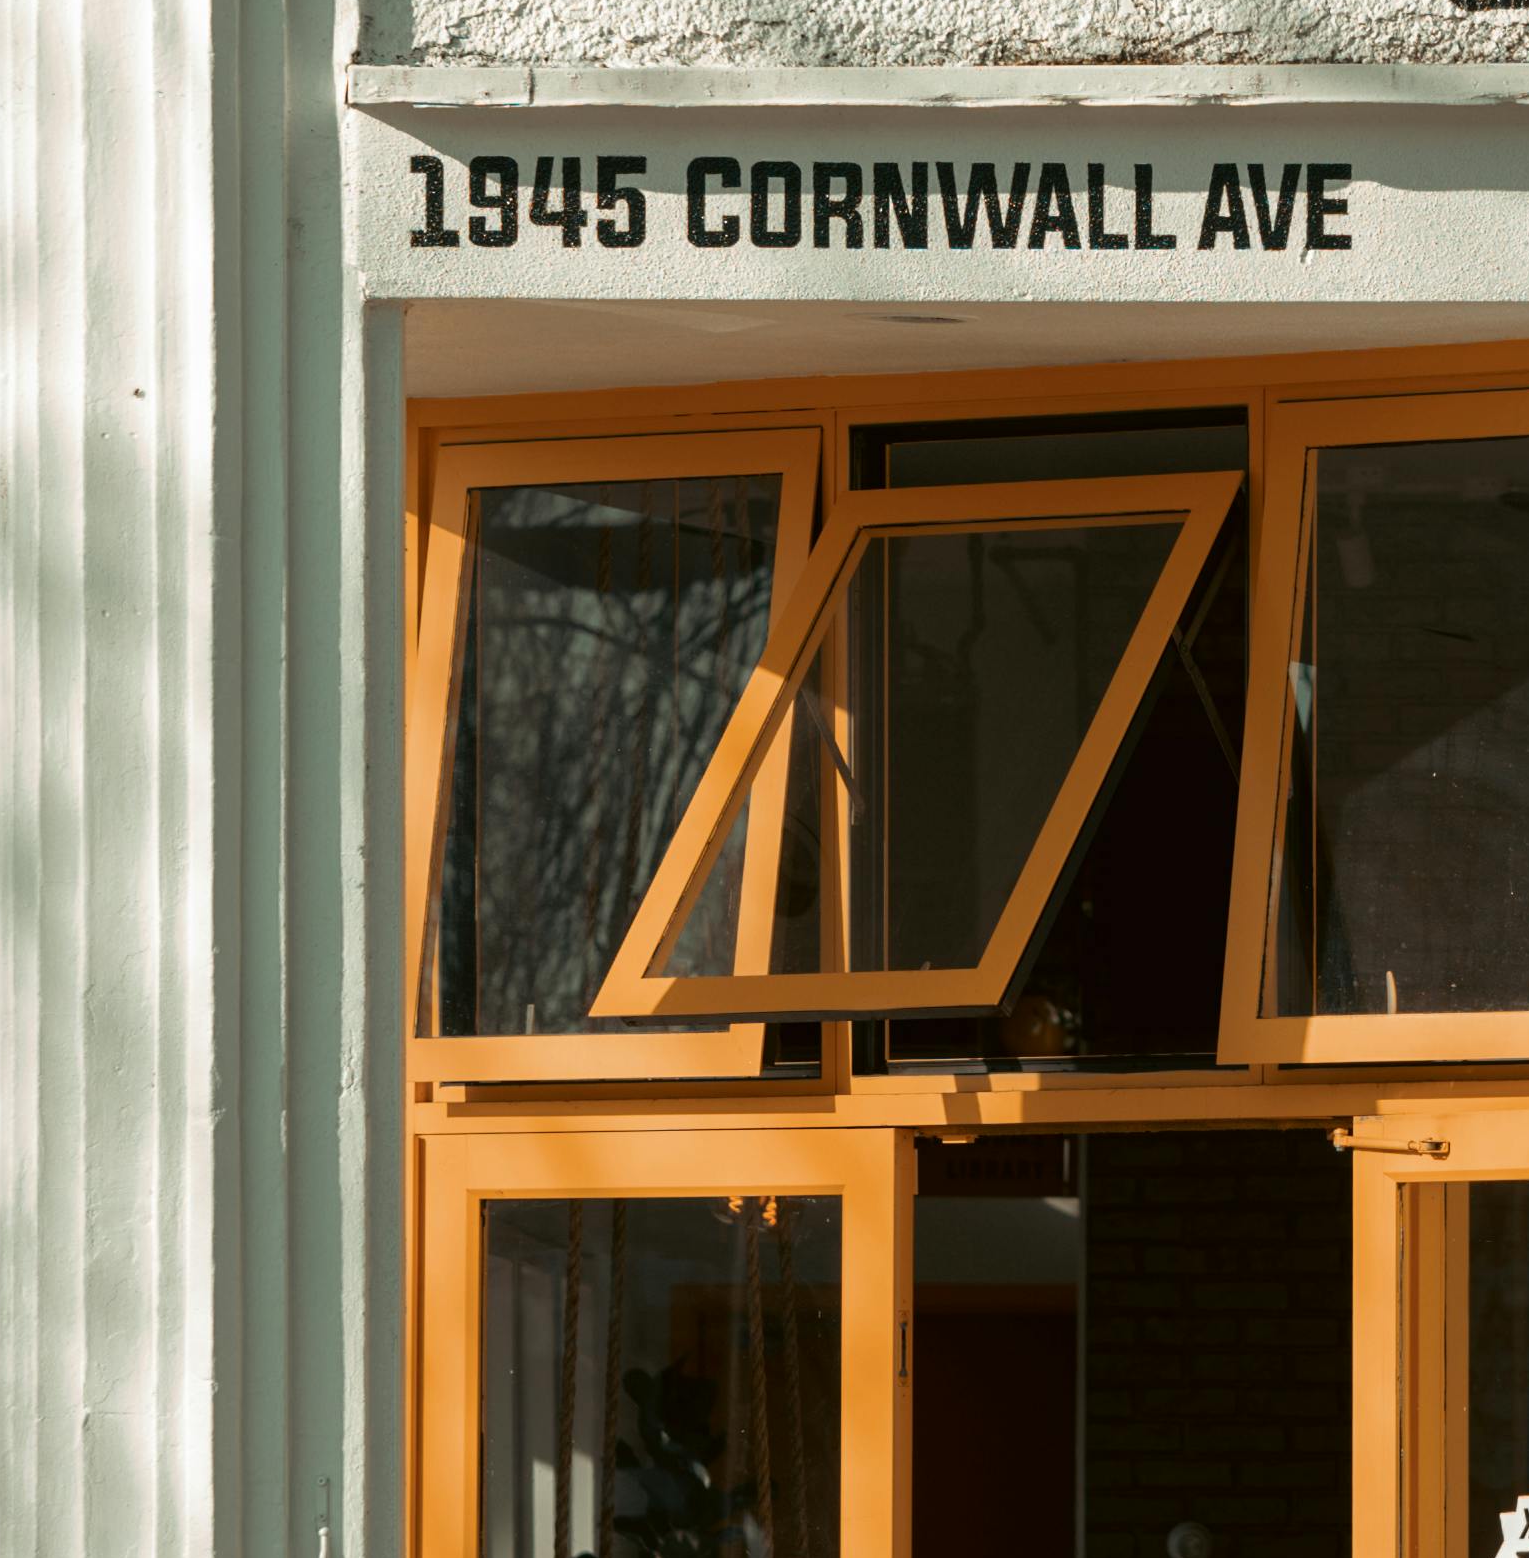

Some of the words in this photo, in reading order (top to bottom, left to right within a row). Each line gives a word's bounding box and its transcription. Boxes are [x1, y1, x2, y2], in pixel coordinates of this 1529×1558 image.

[409, 154, 648, 249] 1945
[686, 155, 1177, 250] CORNWALL
[1197, 162, 1354, 252] AVE
